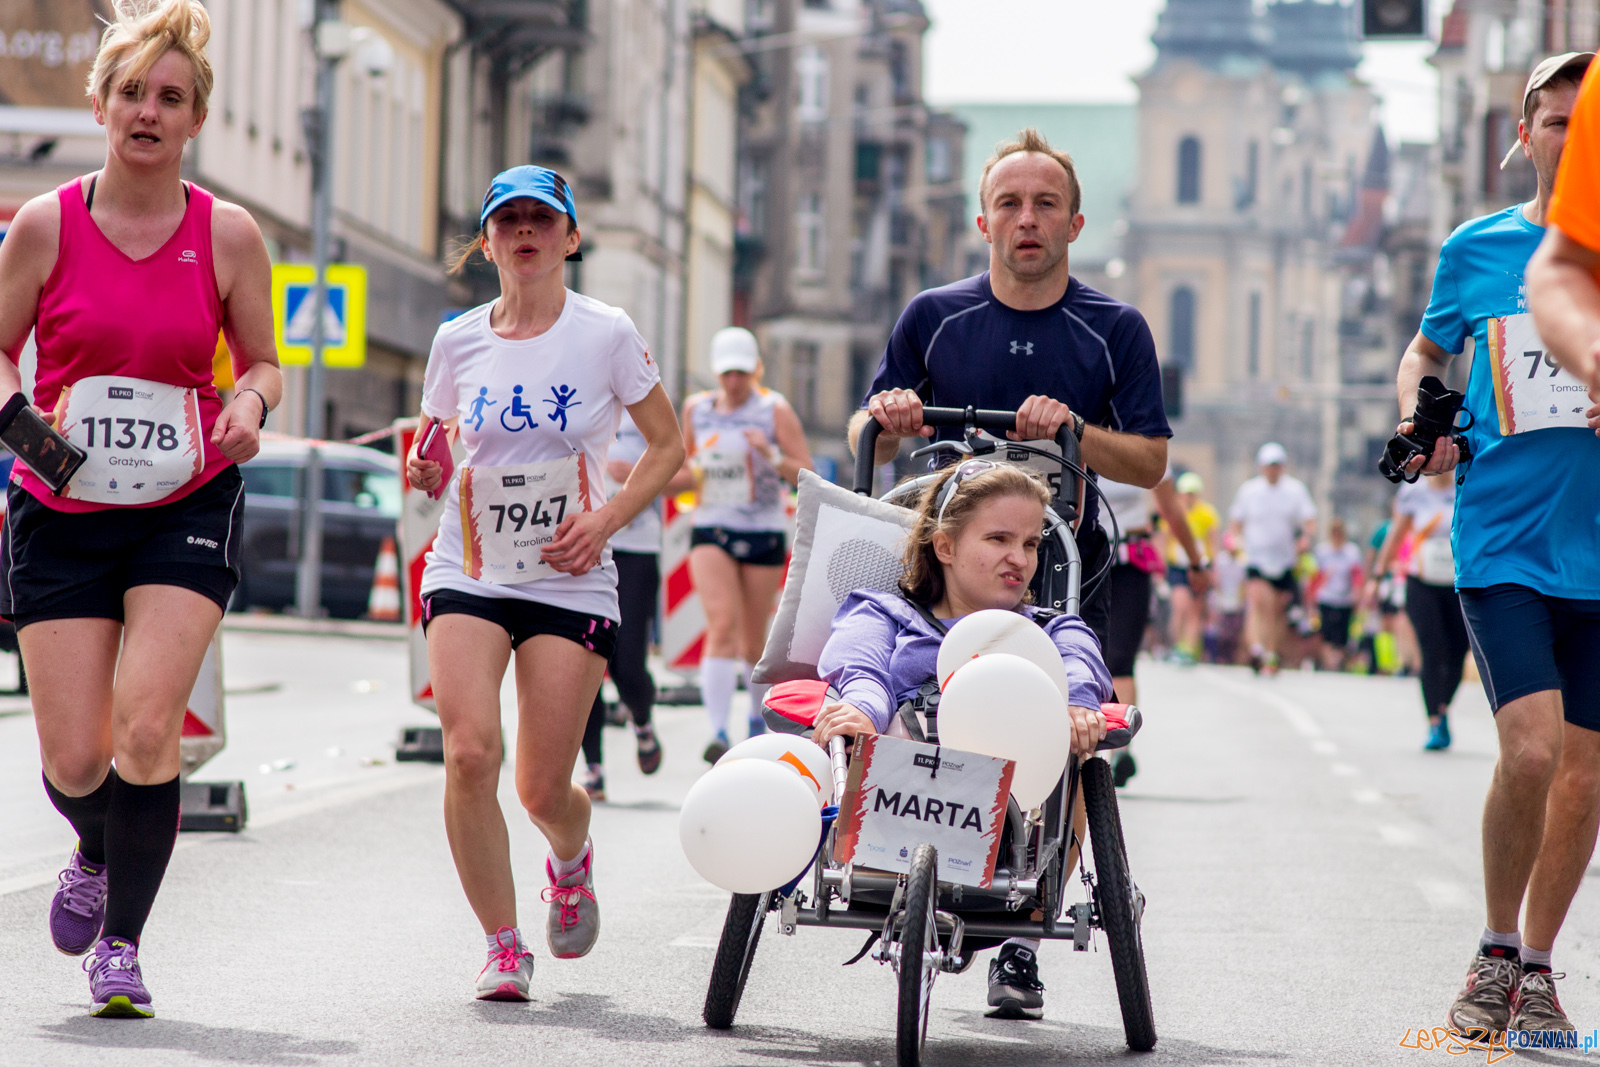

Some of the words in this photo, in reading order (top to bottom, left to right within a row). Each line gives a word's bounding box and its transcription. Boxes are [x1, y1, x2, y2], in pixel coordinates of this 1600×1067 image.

[0, 27, 98, 67] .org.pl
[1523, 350, 1564, 379] 79
[1550, 384, 1589, 393] Tomasz
[81, 416, 179, 451] 11378
[109, 456, 153, 468] Grażyna
[489, 494, 567, 533] 7947
[194, 537, 219, 549] HI-TEC
[513, 536, 553, 548] Karolina
[873, 788, 983, 833] MARTA
